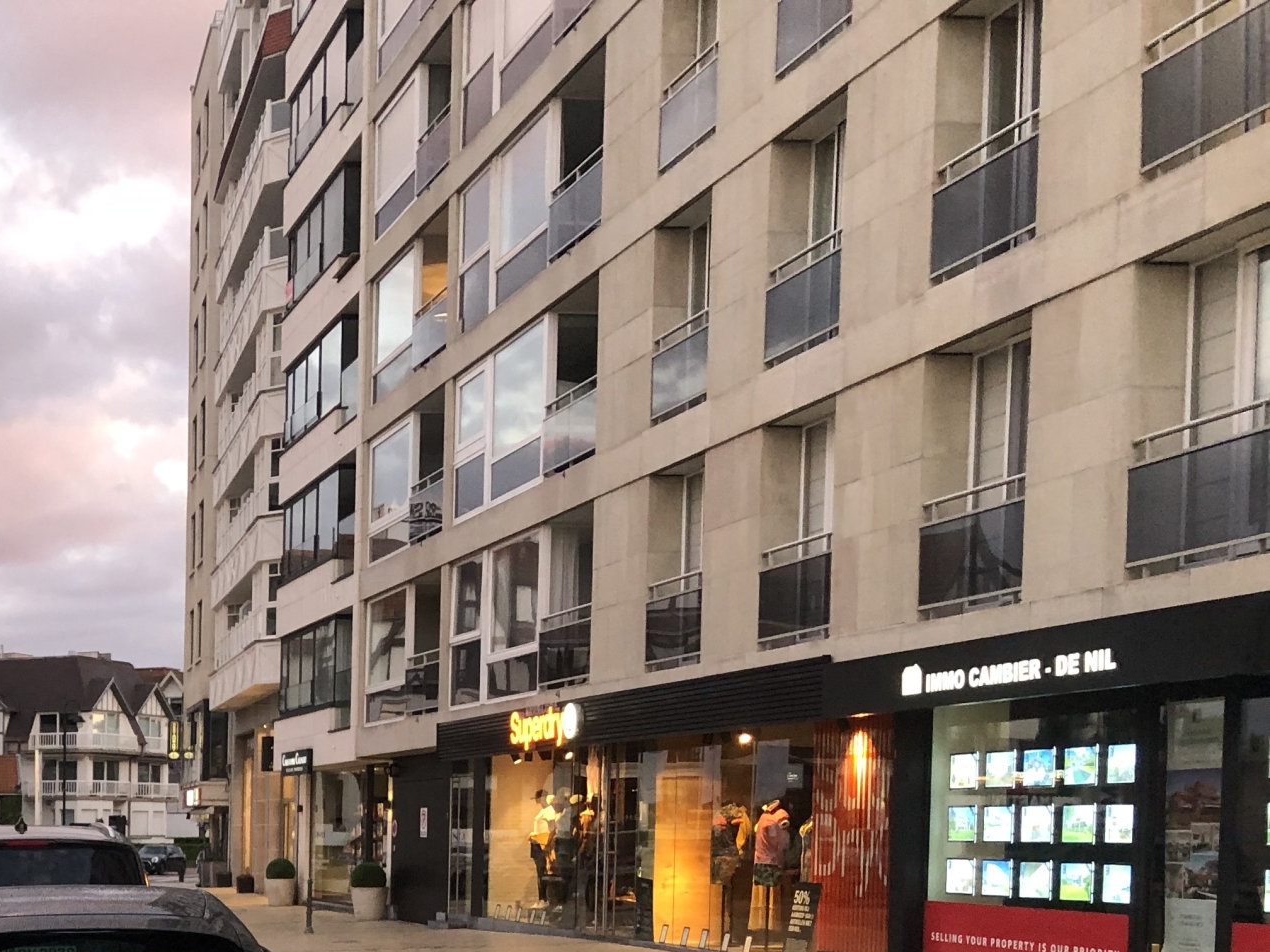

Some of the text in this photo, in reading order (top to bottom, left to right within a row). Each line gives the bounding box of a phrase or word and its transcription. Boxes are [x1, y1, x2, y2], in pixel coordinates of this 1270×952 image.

[926, 668, 965, 692] IMMO
[968, 658, 1041, 687] CAMBIER
[1055, 653, 1080, 676] DE
[1085, 648, 1117, 672] NIL
[510, 706, 565, 751] Superdry
[794, 890, 810, 905] 50%
[931, 932, 962, 943] SELLING
[966, 935, 987, 946] YOUR
[990, 938, 1034, 951] PROPERTY
[1038, 943, 1046, 952] IS
